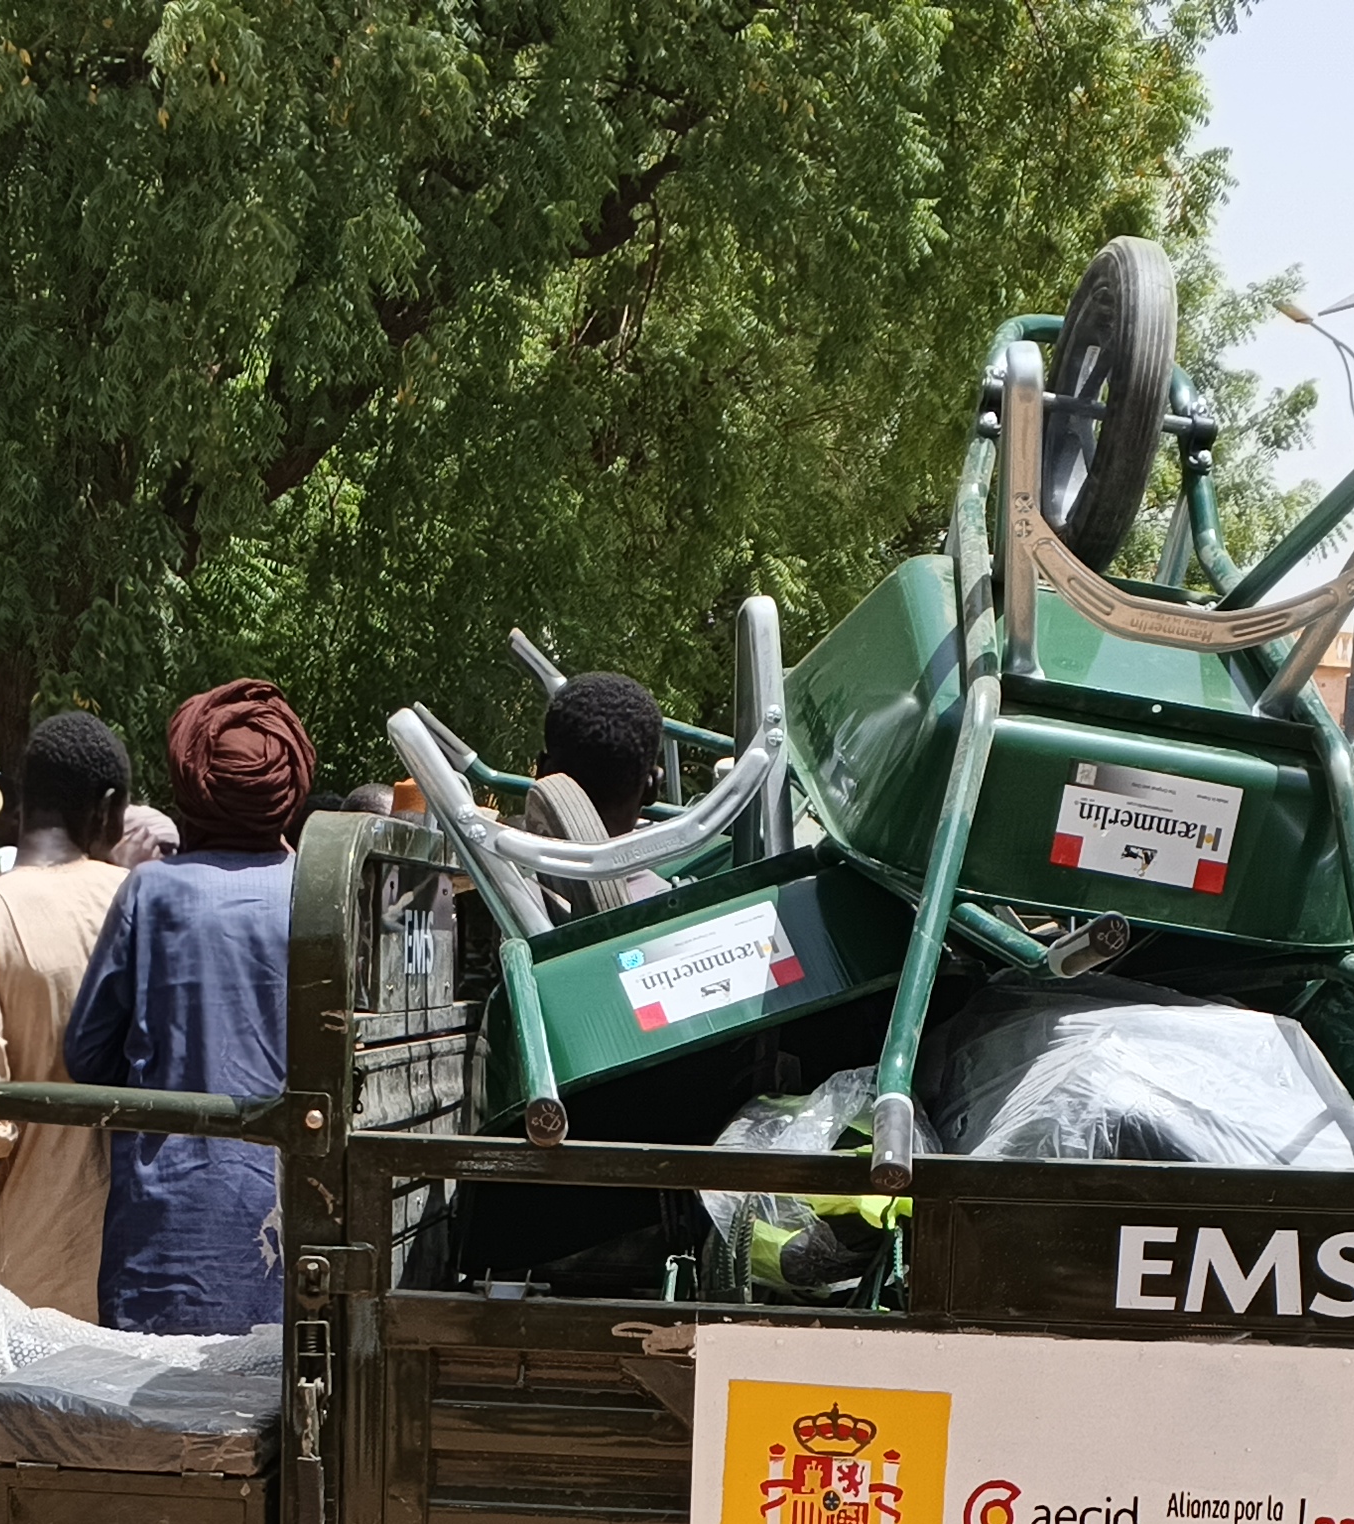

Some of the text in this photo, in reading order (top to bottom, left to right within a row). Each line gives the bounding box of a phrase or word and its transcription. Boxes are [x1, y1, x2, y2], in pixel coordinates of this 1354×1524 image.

[405, 909, 434, 974] EMS
[1166, 1491, 1229, 1519] Alianza
[1267, 1495, 1283, 1521] la
